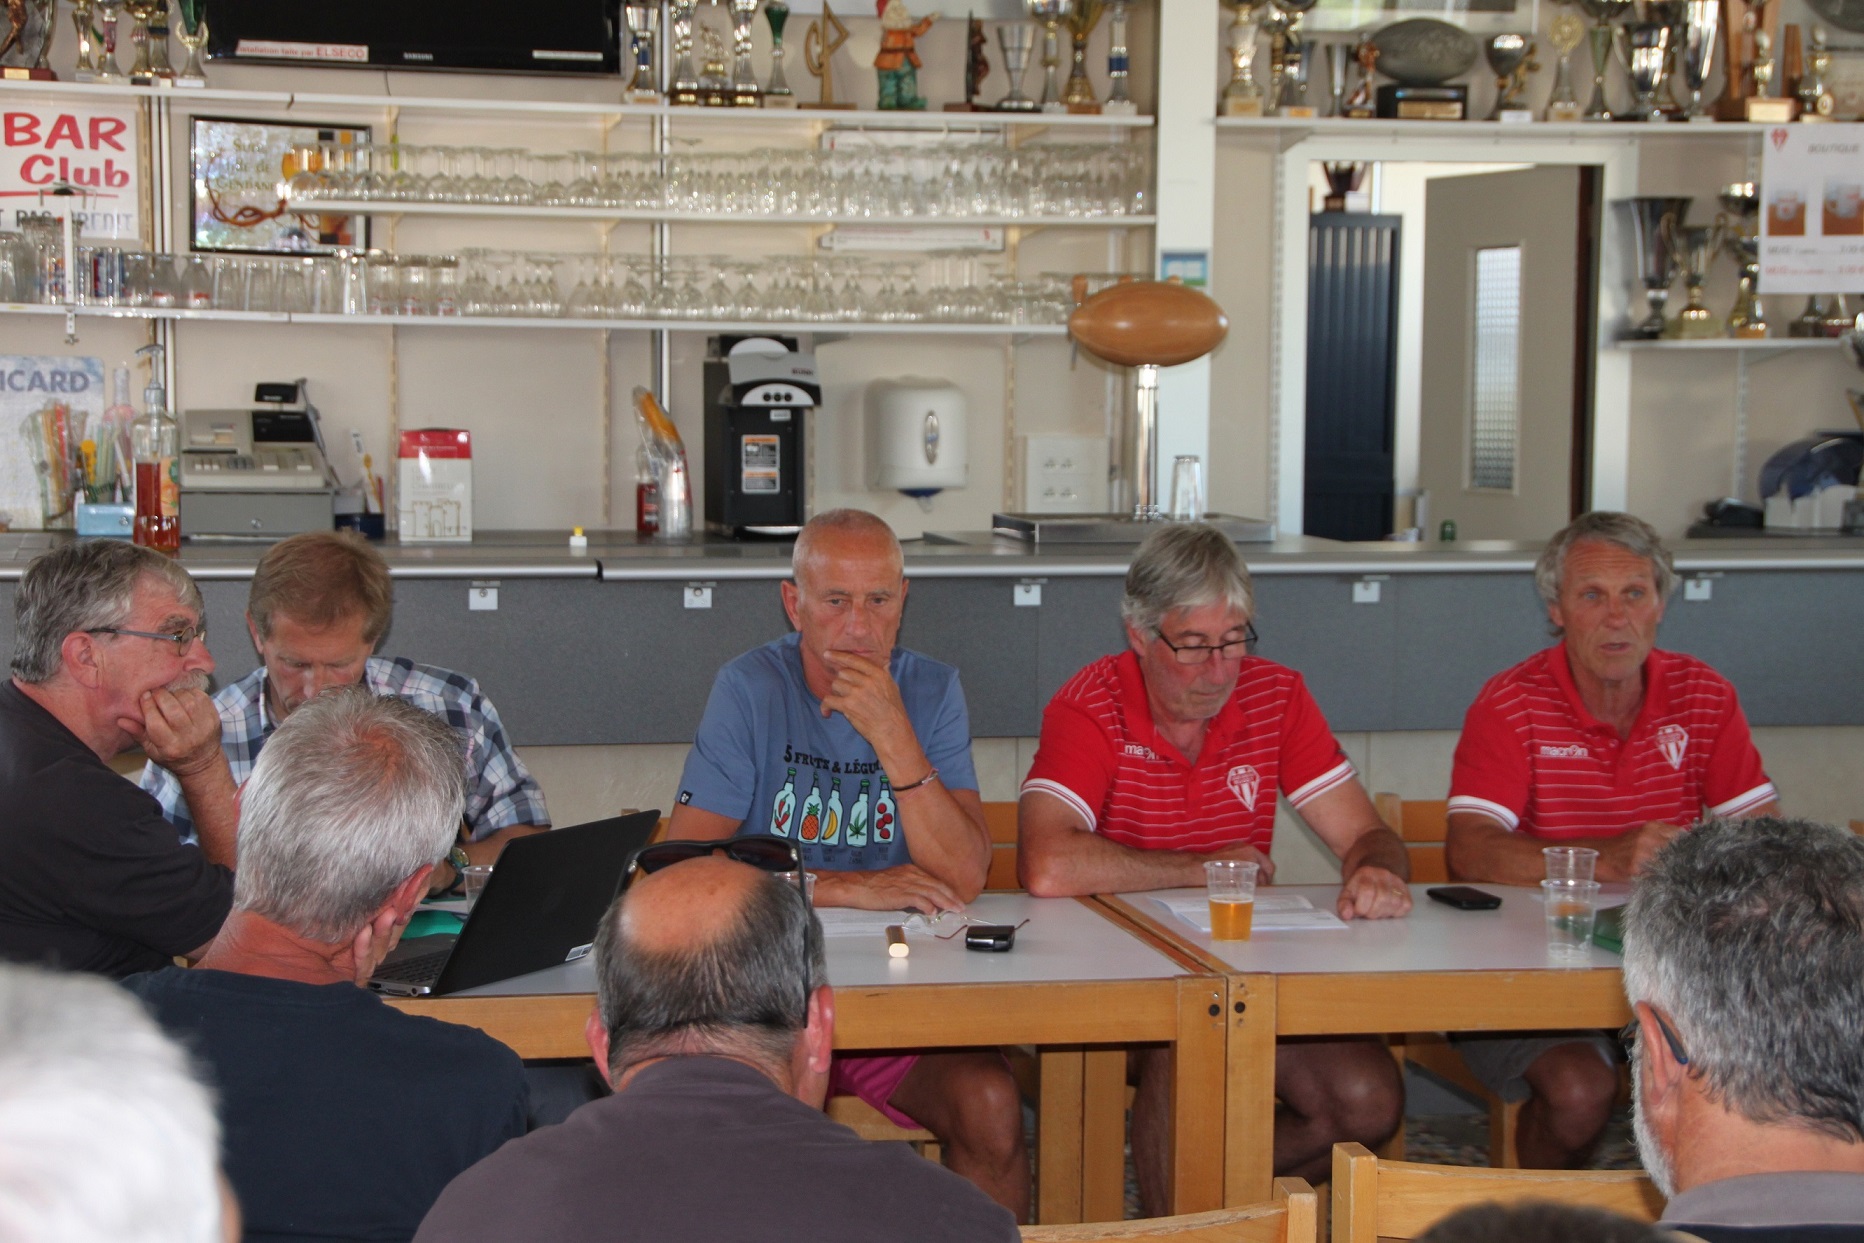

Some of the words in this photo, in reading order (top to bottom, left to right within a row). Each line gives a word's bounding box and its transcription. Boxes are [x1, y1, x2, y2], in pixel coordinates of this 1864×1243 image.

[4, 112, 127, 152] BAR
[20, 154, 130, 188] Club
[784, 744, 793, 763] 5
[832, 761, 841, 774] &
